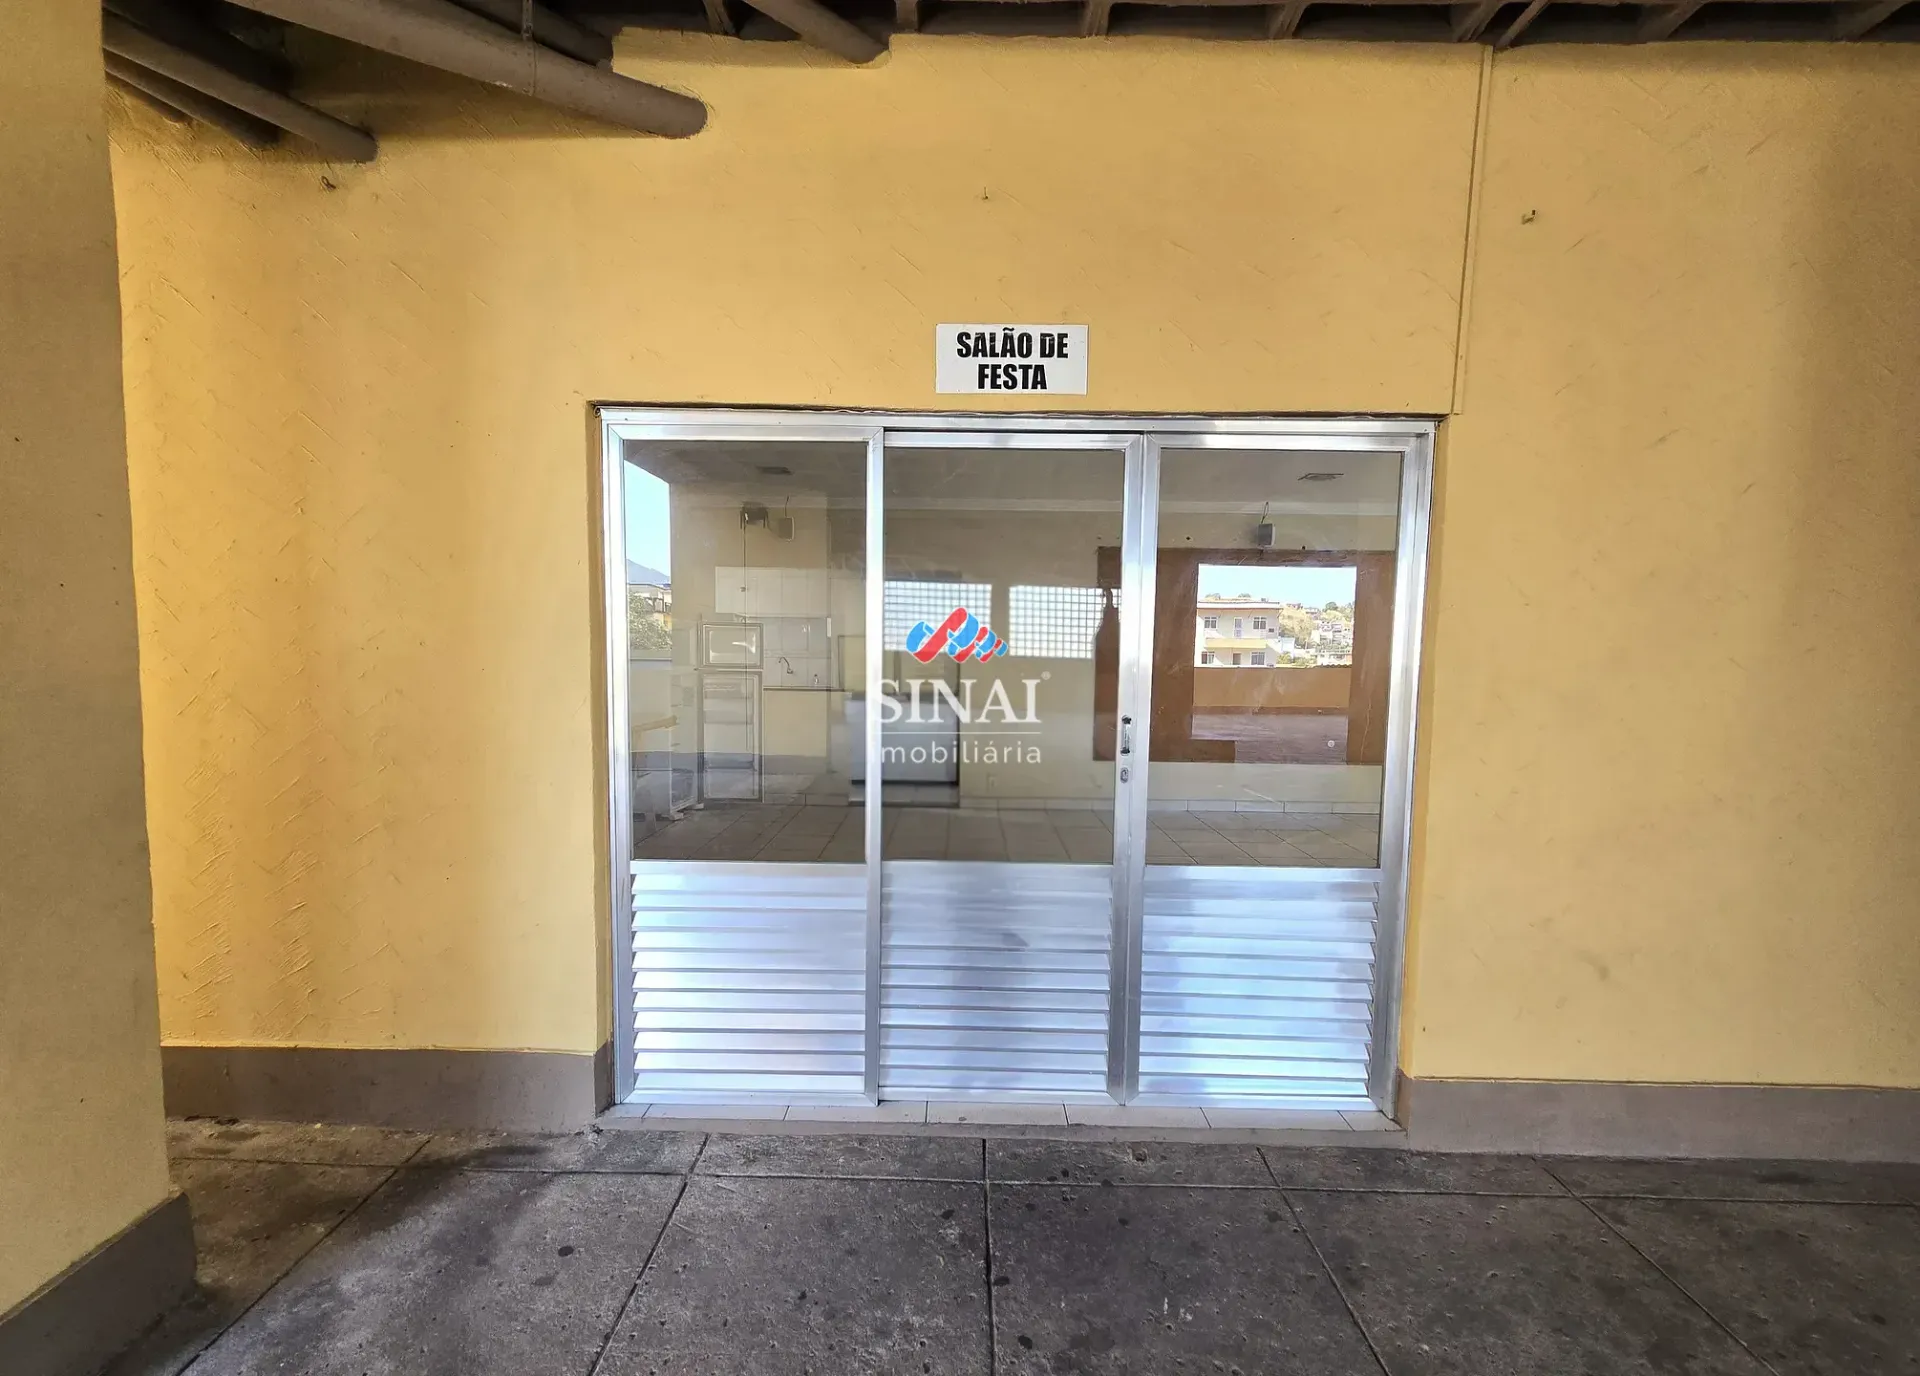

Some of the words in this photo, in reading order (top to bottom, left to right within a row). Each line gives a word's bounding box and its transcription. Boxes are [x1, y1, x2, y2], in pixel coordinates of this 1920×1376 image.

[956, 327, 1033, 358] SALÃO
[1039, 332, 1069, 359] DE
[977, 363, 1048, 390] FESTA
